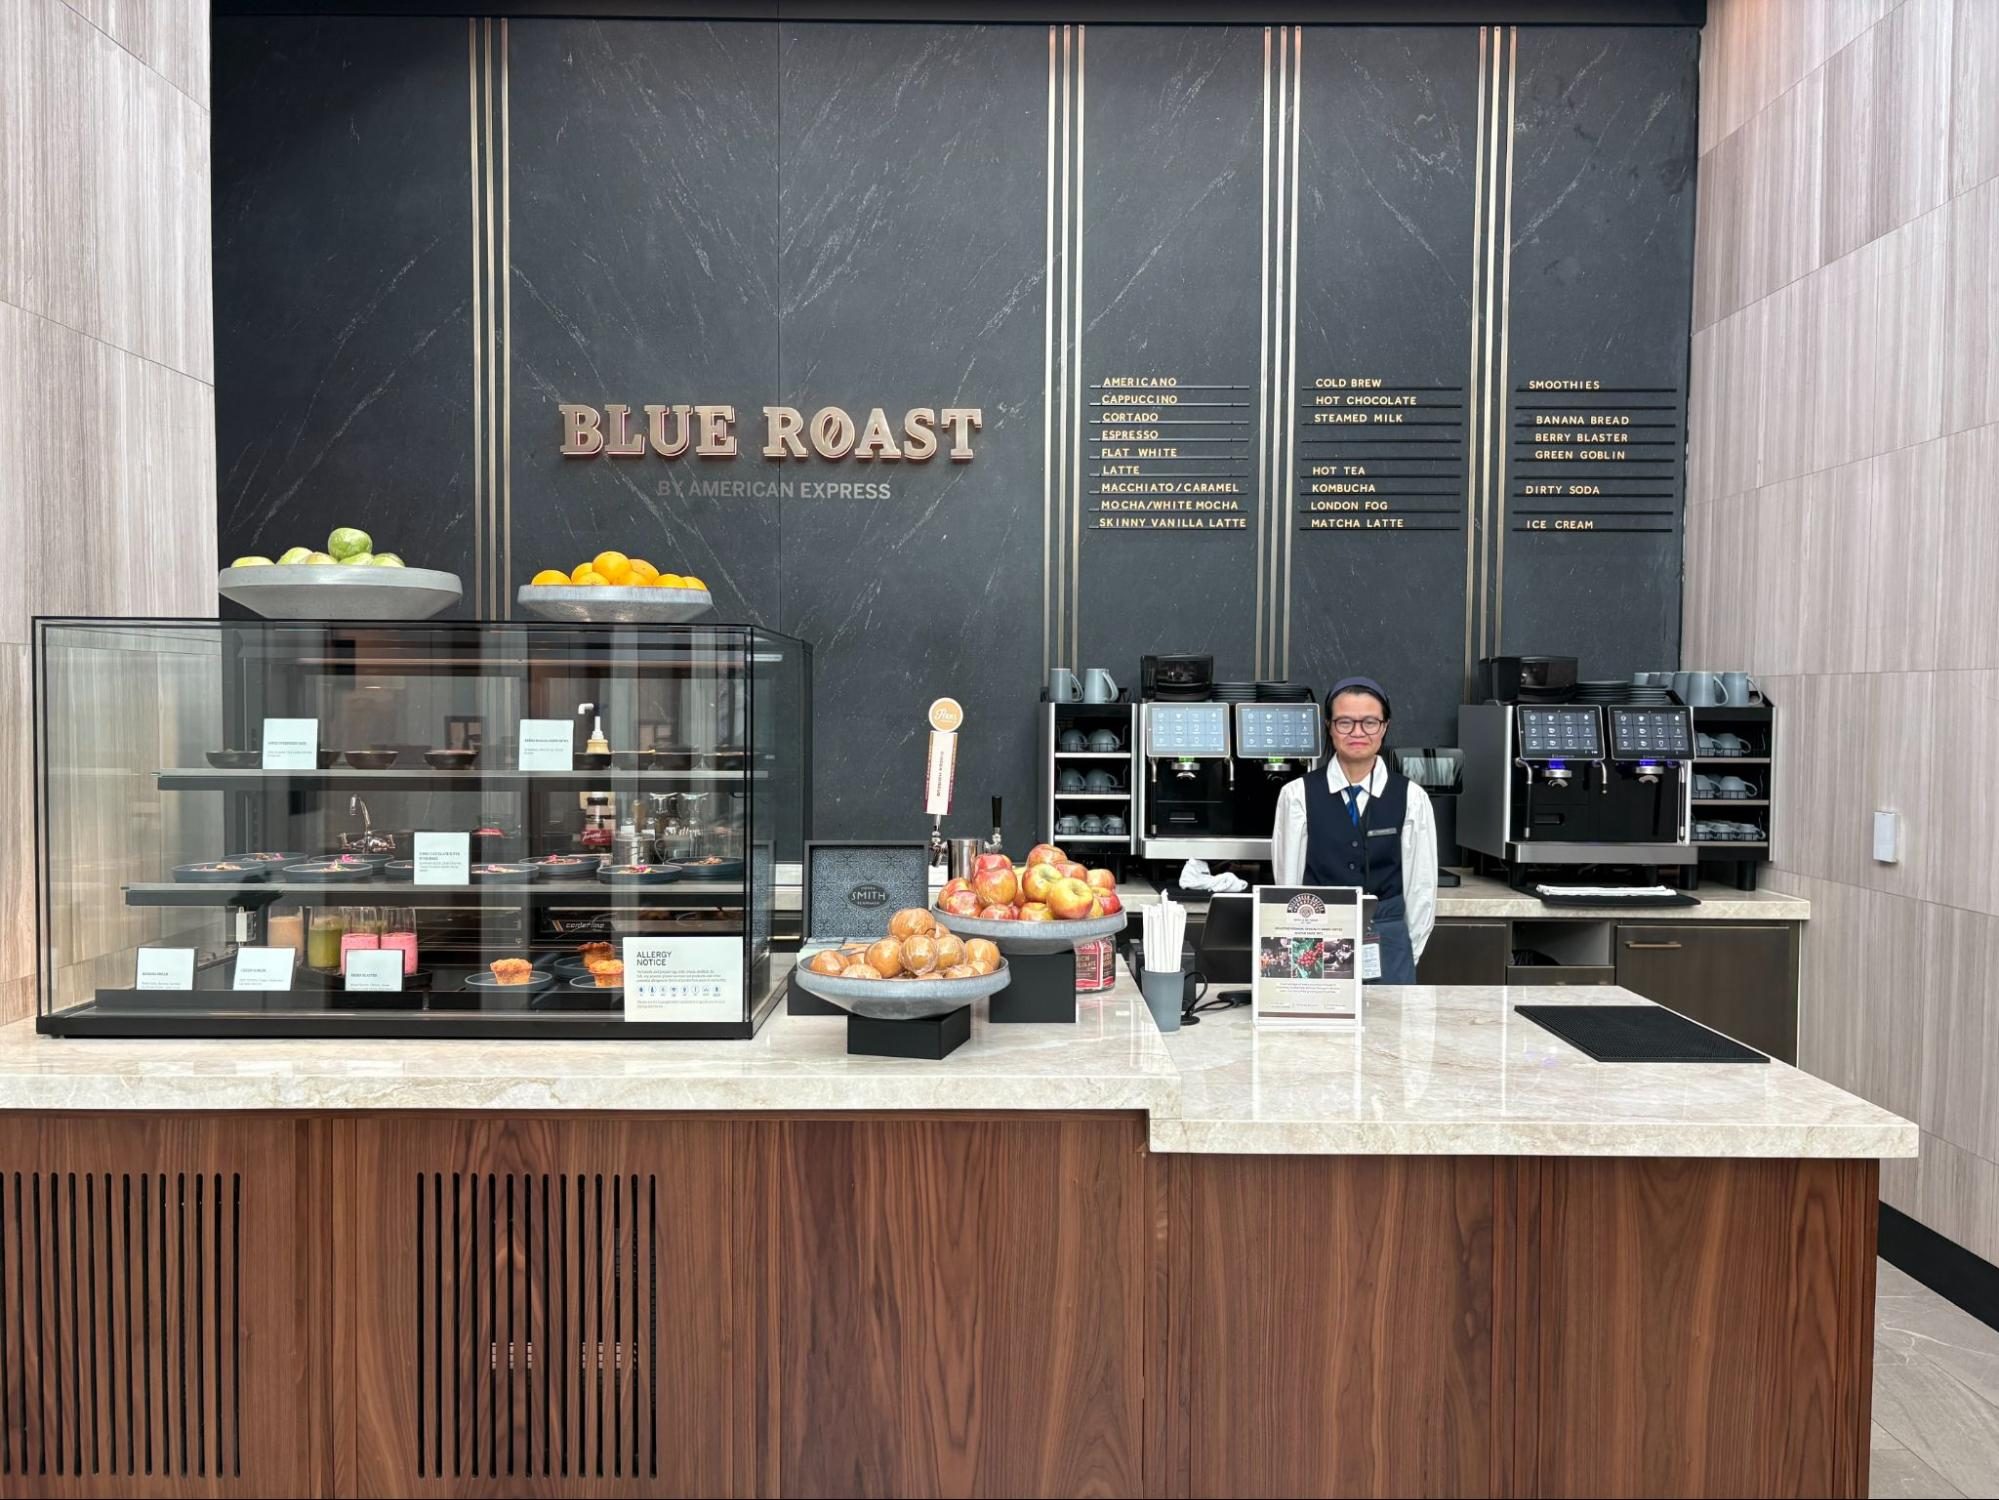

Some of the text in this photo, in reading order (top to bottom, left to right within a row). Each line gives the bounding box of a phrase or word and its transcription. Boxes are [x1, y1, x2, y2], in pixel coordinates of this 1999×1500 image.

[1103, 377, 1177, 386] AMERICANO
[1315, 378, 1382, 388] COLD BREW
[1529, 380, 1600, 390] SMOOTHIES
[1101, 395, 1178, 404] CAPPUCCINO
[1315, 396, 1416, 405] HOT CHOCOLATE
[1102, 413, 1158, 422] CORTADO
[1314, 414, 1403, 423] STEAMED MILK
[1536, 416, 1629, 425] BANANA BREAD
[558, 404, 983, 461] BLUE ROAST
[1102, 430, 1159, 440] ESPRESSO
[1535, 433, 1628, 442] BERRY BLASTER
[1101, 448, 1177, 457] FLAT WHITE
[1535, 450, 1625, 460] GREEN GOBLIN
[1103, 466, 1140, 475] LATTE
[1312, 466, 1365, 475] HOT TEA
[658, 481, 892, 501] BY AMERICAN EXPRESS
[1101, 483, 1239, 492] MACCHIATO/CARAMEL
[1312, 484, 1376, 493] KOMBUCHA
[1525, 485, 1600, 495] DIRTY SODA
[1101, 500, 1239, 510] MOCHA/WHITE MOCHA
[1311, 501, 1388, 511] LONDON FOG
[1099, 518, 1246, 528] SKINNY VANILLA LATTE
[1311, 519, 1404, 528] MATCHA LATTE
[1527, 520, 1593, 529] ICE CREAM
[852, 891, 886, 901] SMITH
[636, 951, 672, 959] ALLERGY
